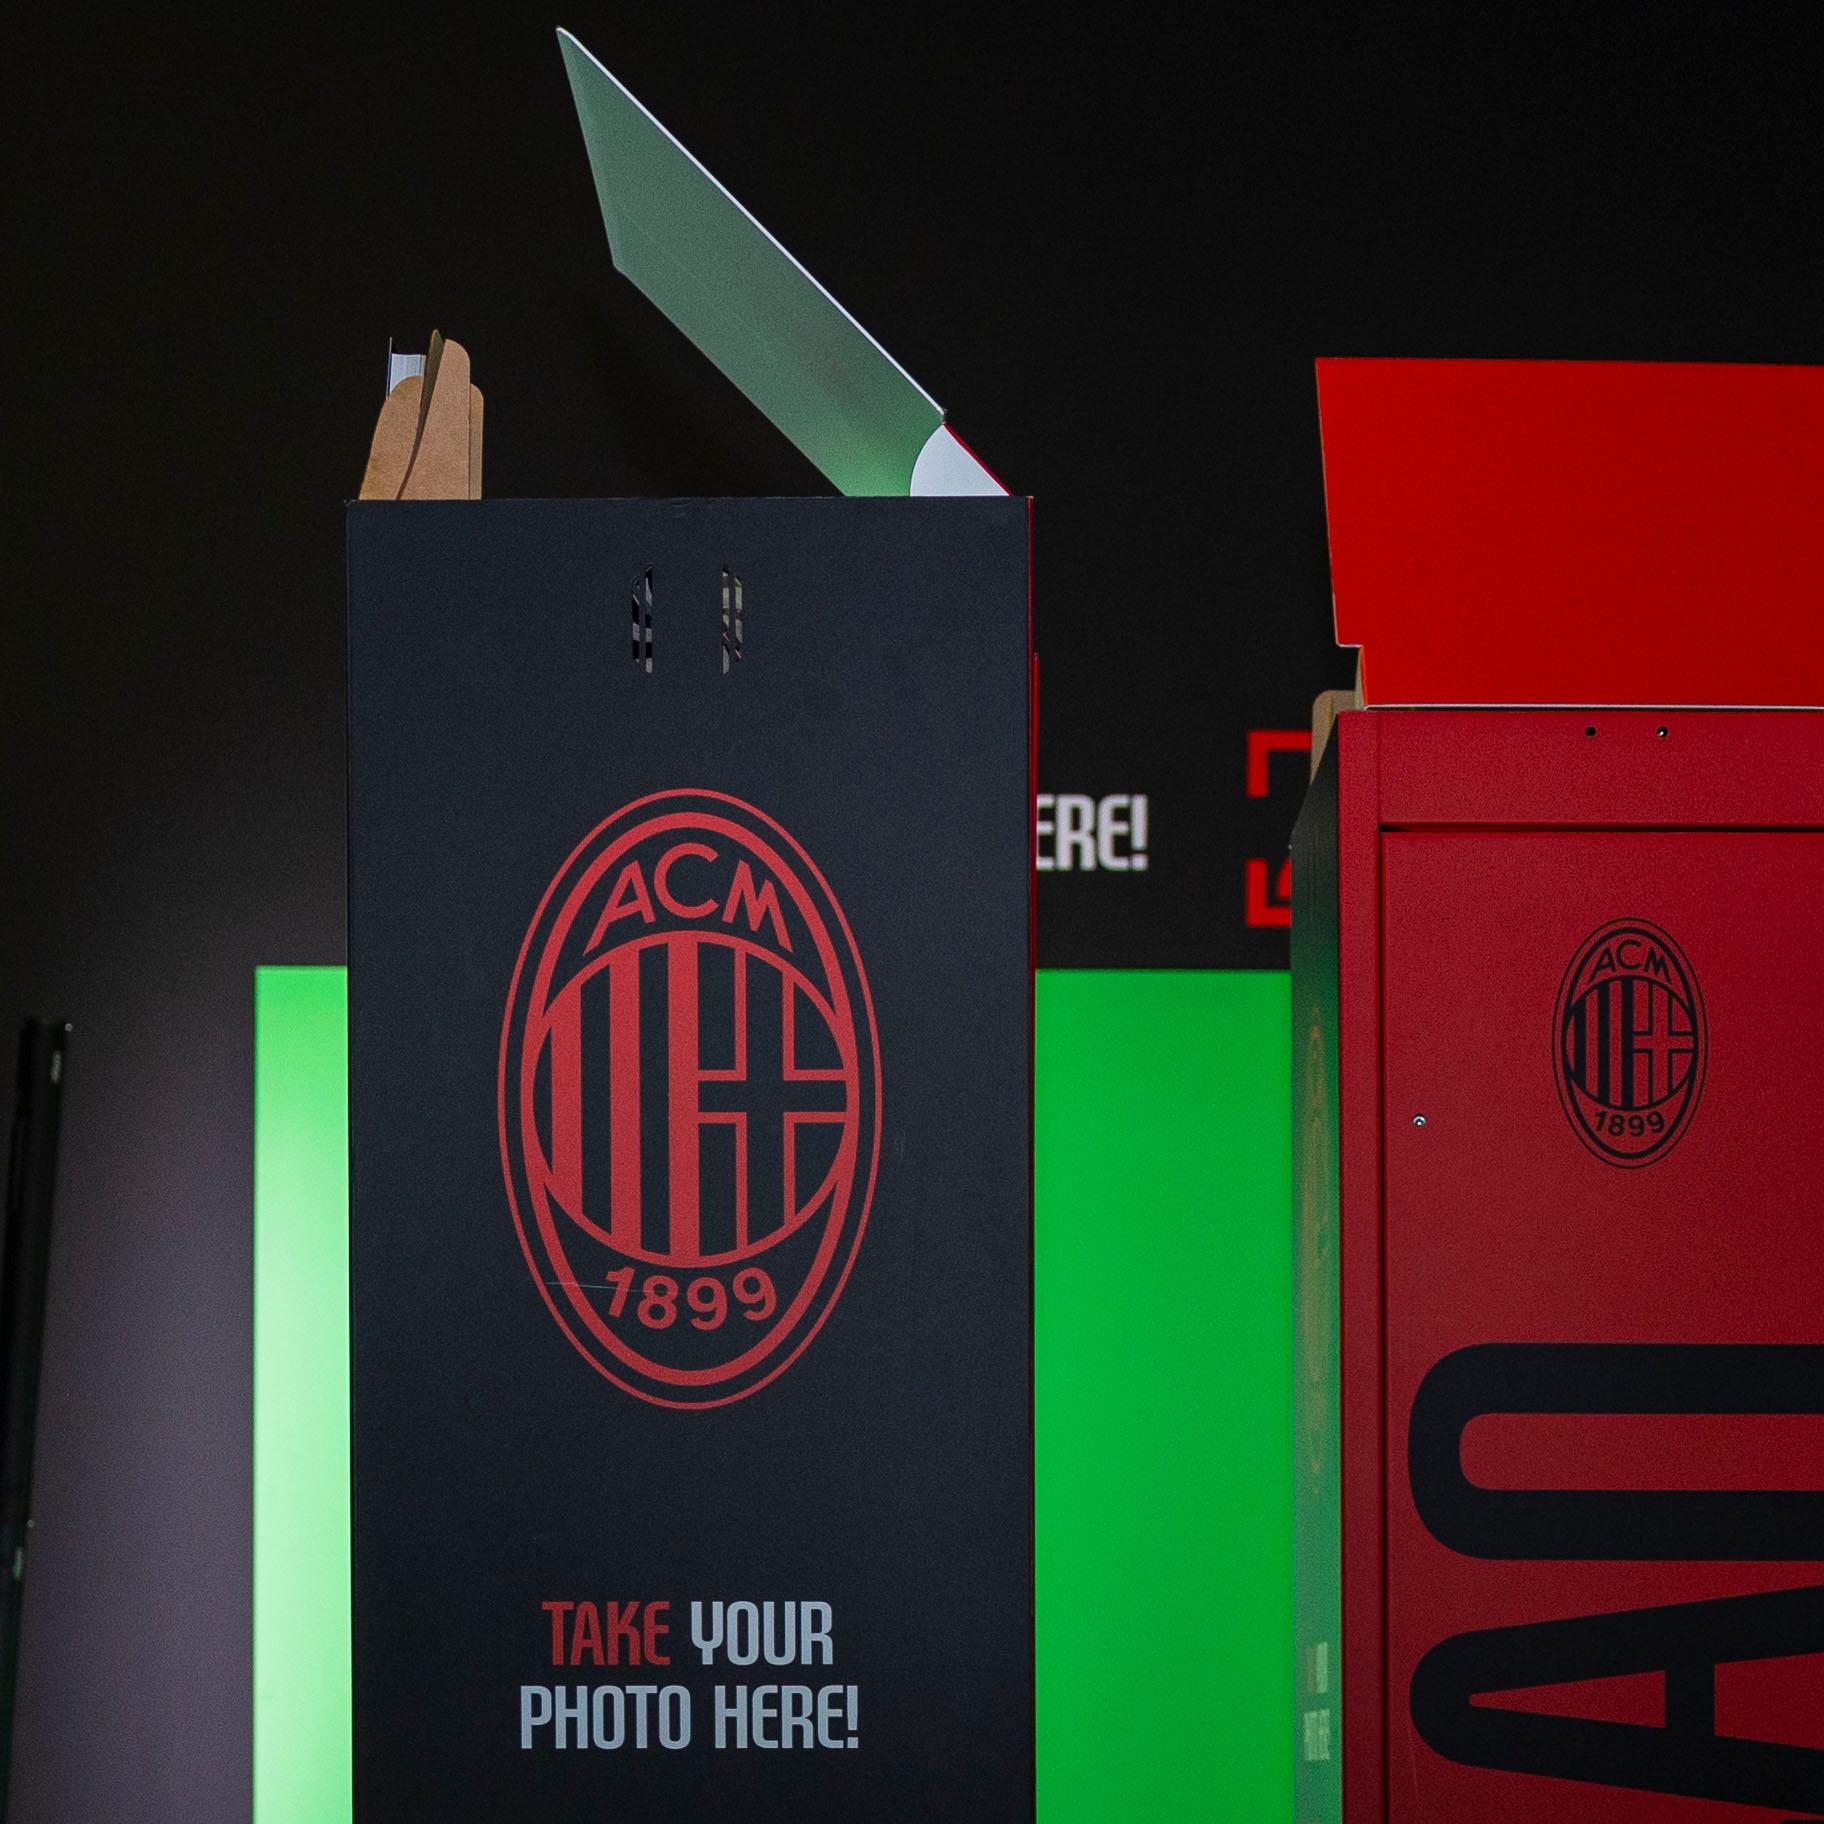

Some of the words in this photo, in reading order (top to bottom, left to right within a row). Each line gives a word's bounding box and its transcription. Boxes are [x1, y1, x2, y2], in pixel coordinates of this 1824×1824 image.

[1036, 793, 1149, 872] ERE!
[583, 842, 793, 957] ACM
[1587, 938, 1672, 985] ACM
[1594, 1110, 1665, 1138] 1899
[603, 1266, 777, 1332] 1899
[540, 1600, 672, 1667] TAKE
[690, 1600, 835, 1667] YOUR
[519, 1684, 692, 1750] PHOTO
[714, 1684, 860, 1750] HERE!
